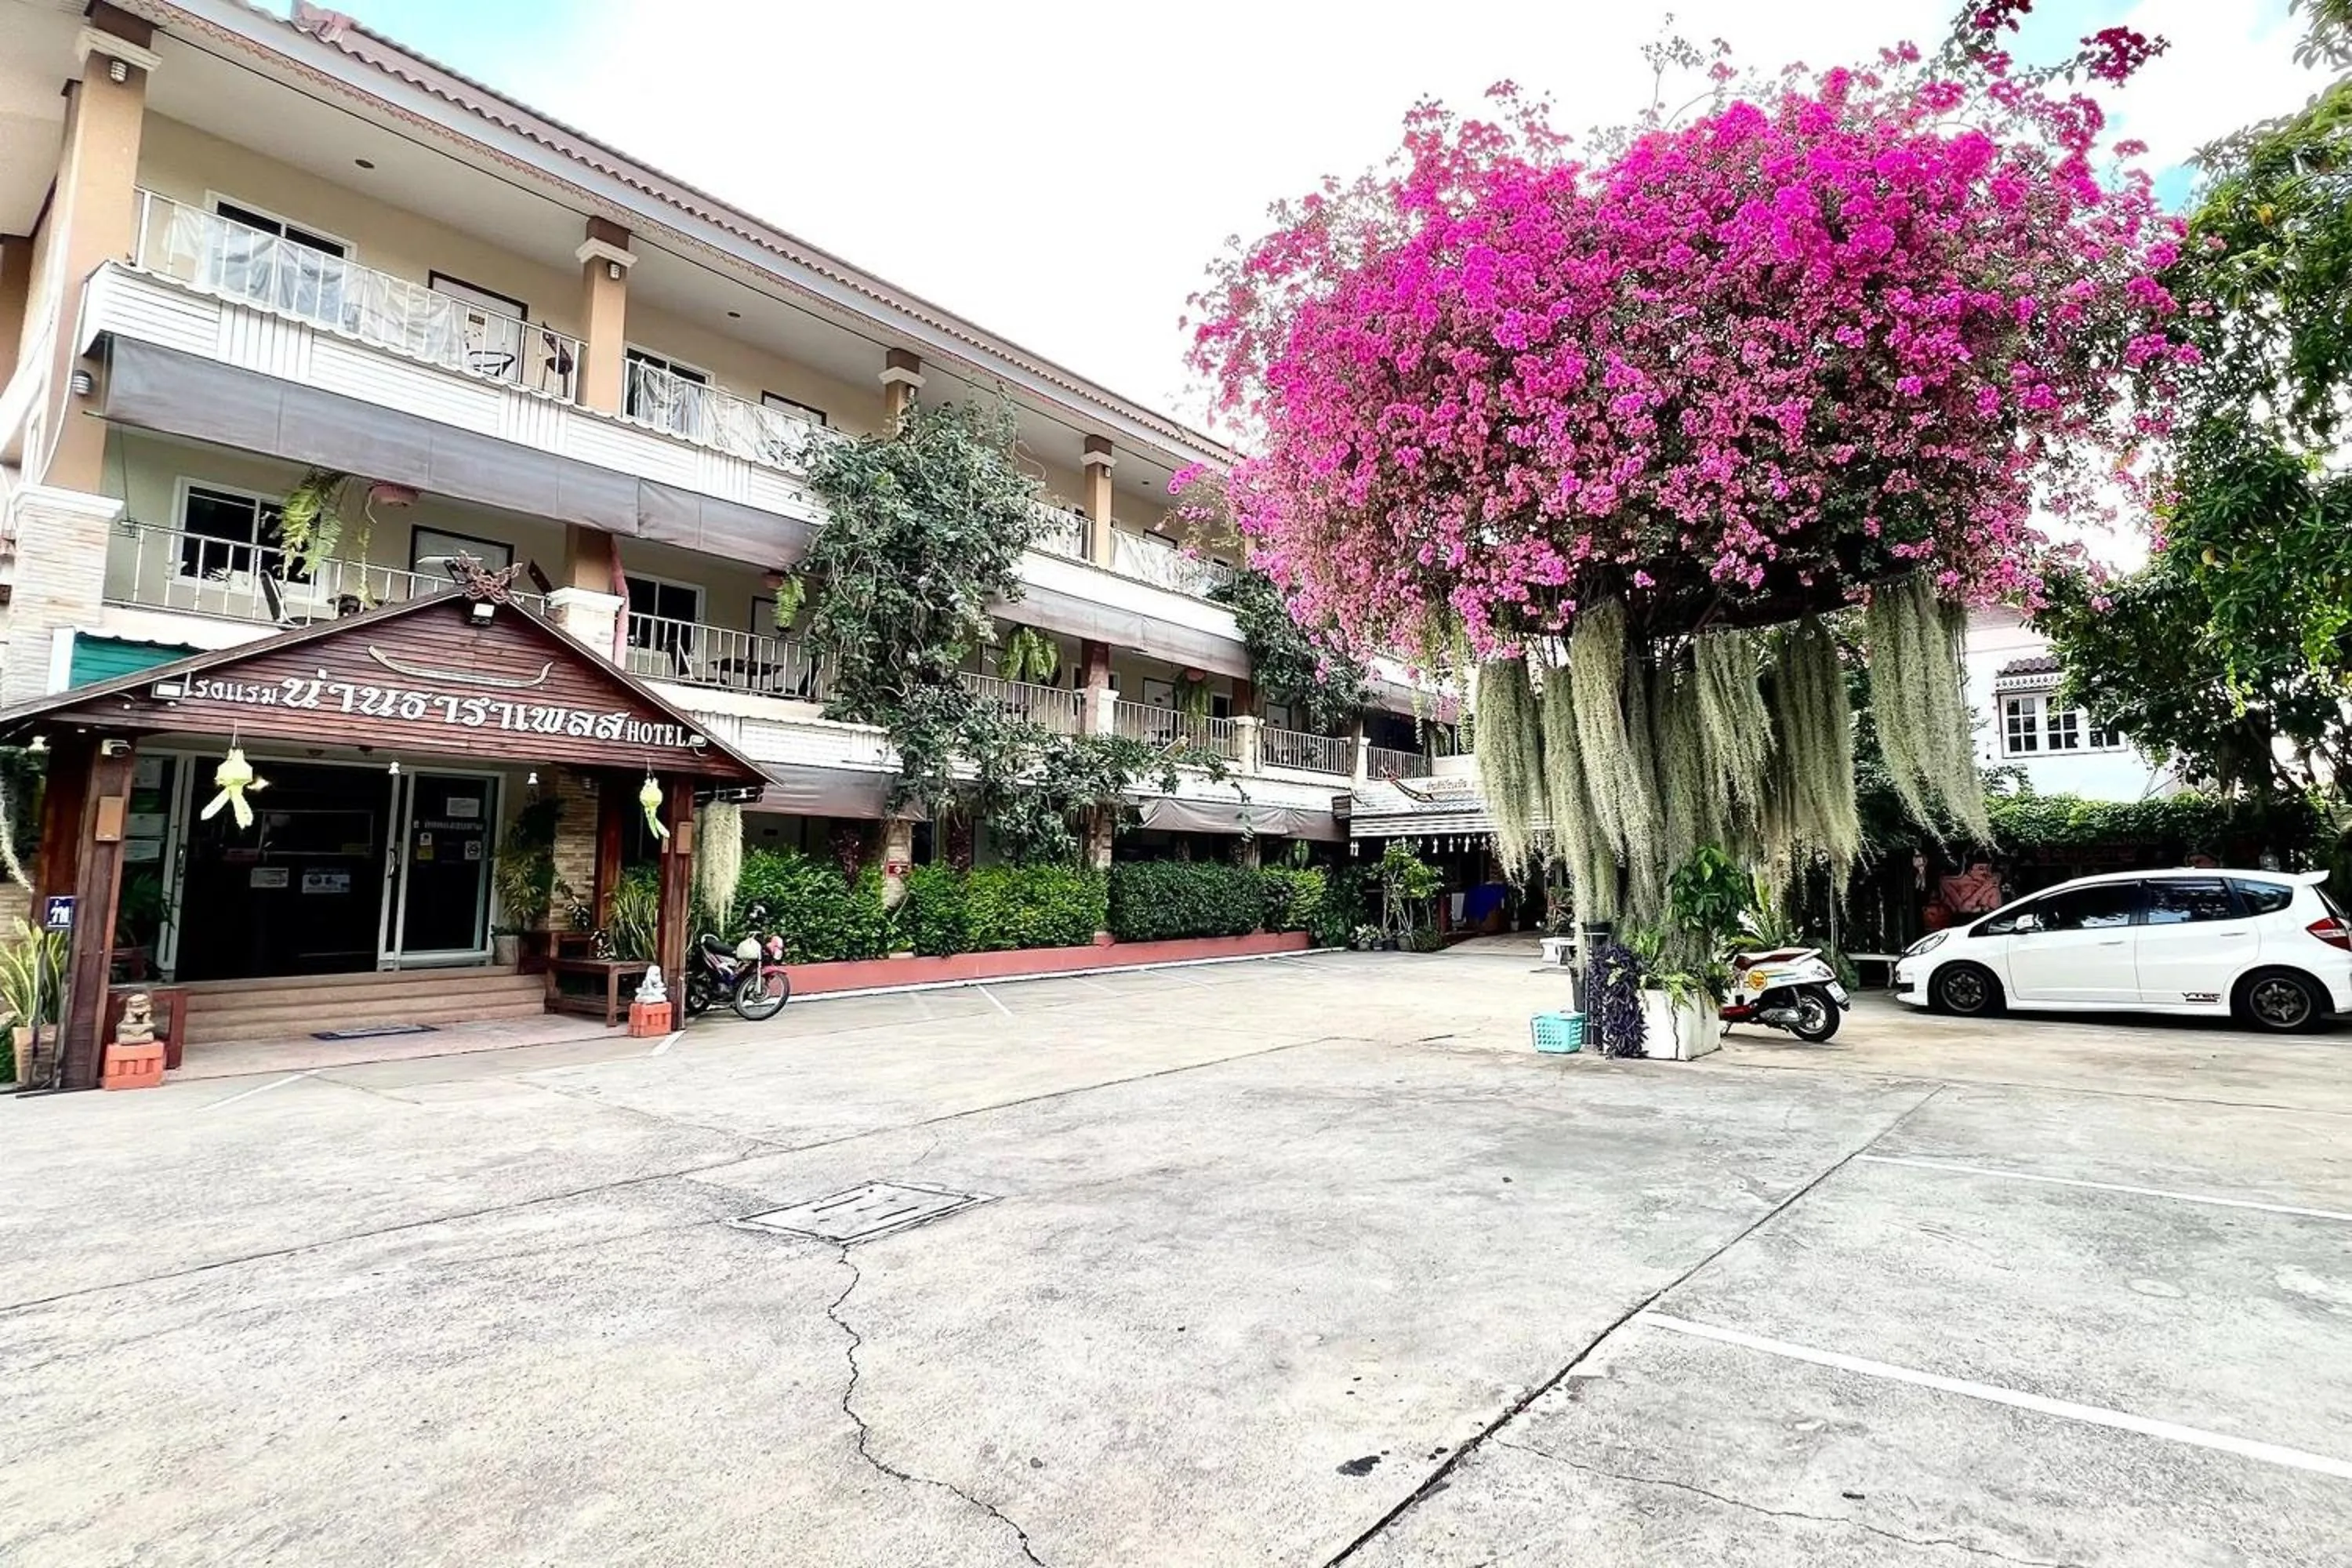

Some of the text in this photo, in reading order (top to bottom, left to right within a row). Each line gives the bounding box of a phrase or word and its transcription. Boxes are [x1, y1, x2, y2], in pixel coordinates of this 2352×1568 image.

[281, 668, 630, 740] น่านธาราเพลส
[626, 720, 687, 747] HOTEL
